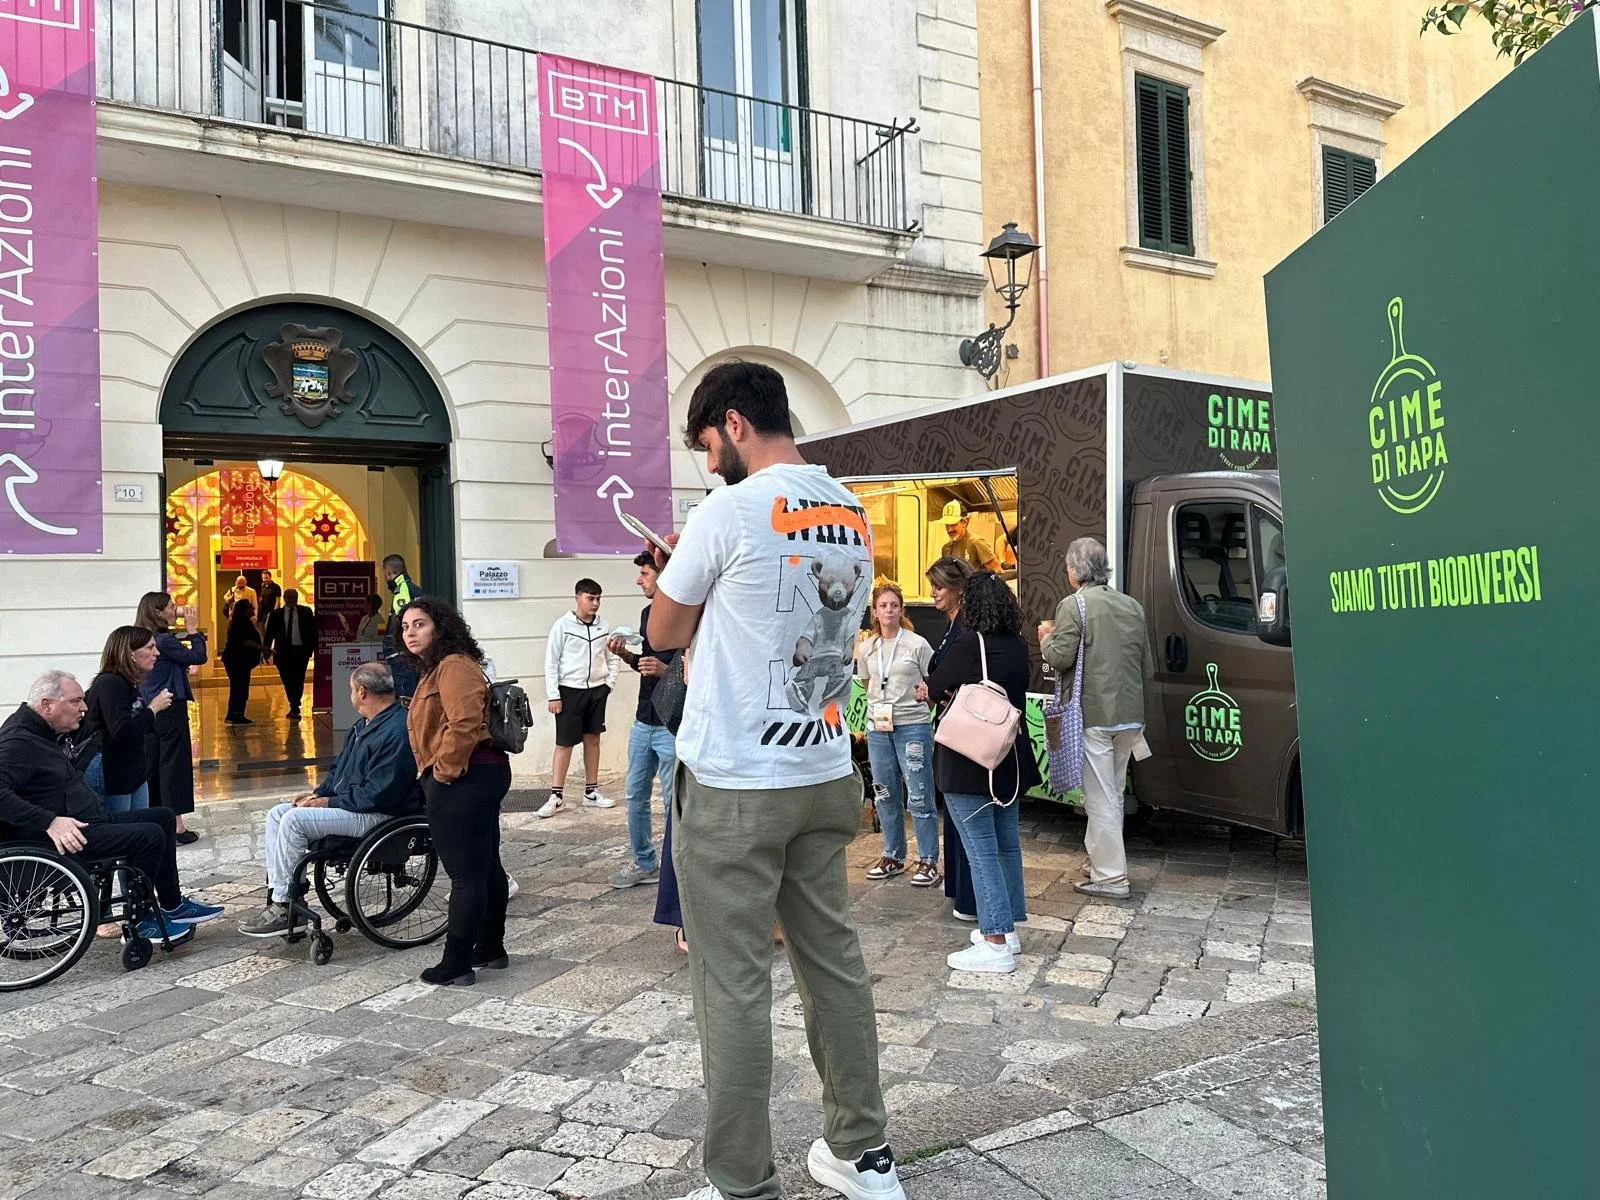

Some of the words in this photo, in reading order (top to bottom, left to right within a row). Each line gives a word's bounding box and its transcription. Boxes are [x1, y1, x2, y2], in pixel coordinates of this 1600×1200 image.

[562, 87, 636, 121] BTM
[0, 145, 36, 430] interAzioni
[588, 226, 631, 457] interAzioni
[1208, 393, 1270, 432] CIME
[1368, 380, 1445, 449] CIME
[917, 431, 955, 471] CIME
[1010, 420, 1056, 465] CIME
[1208, 426, 1225, 449] DI
[1230, 429, 1272, 454] RAPA
[1371, 450, 1391, 483] DI
[1395, 431, 1448, 477] RAPA
[1003, 440, 1017, 459] DI
[1016, 450, 1047, 480] RAPA
[1065, 456, 1105, 501] CIM
[122, 488, 136, 498] 10
[1059, 477, 1073, 496] DI
[324, 582, 365, 594] BTM
[479, 570, 508, 578] Palazzo
[1329, 567, 1376, 613] SIAMO
[1377, 560, 1425, 610] TUTTI
[1427, 545, 1542, 607] BIODIVERSI
[1185, 704, 1242, 731] CIME
[1186, 725, 1200, 741] DI
[1204, 728, 1243, 747] RAPA
